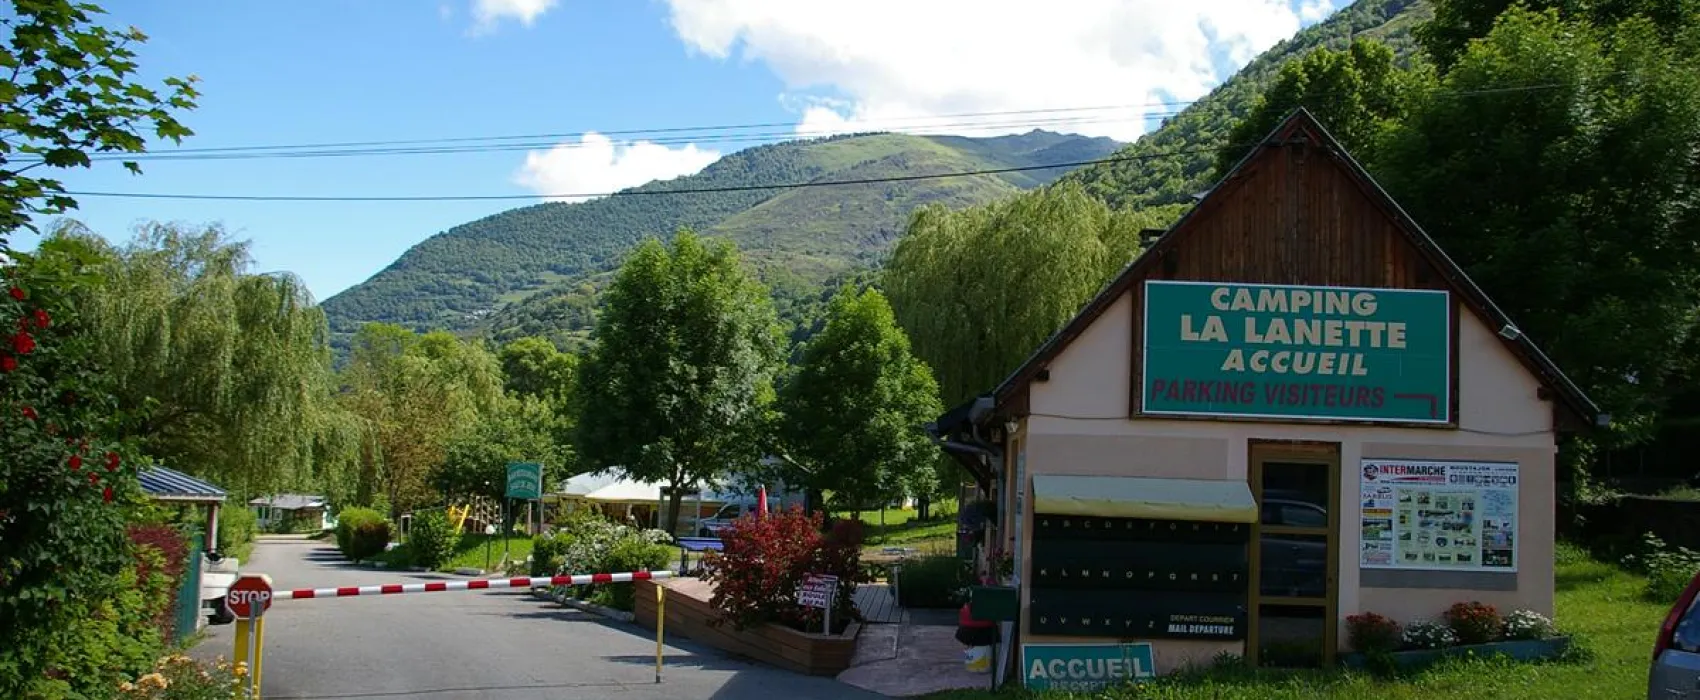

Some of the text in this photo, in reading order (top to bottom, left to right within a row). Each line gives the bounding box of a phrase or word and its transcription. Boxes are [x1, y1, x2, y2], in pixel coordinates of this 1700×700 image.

[1210, 286, 1378, 317] CAMPING
[1180, 314, 1407, 349] LA LANETTE
[1220, 349, 1368, 377] ACCUEIL
[1151, 378, 1385, 409] PARKING VISITEURS
[1379, 464, 1446, 476] INTERMARCHE
[230, 590, 270, 604] STOP
[1169, 614, 1198, 622] DEPART
[1167, 624, 1234, 635] MAIL DEPARTURE
[1030, 658, 1150, 679] ACCUEIL
